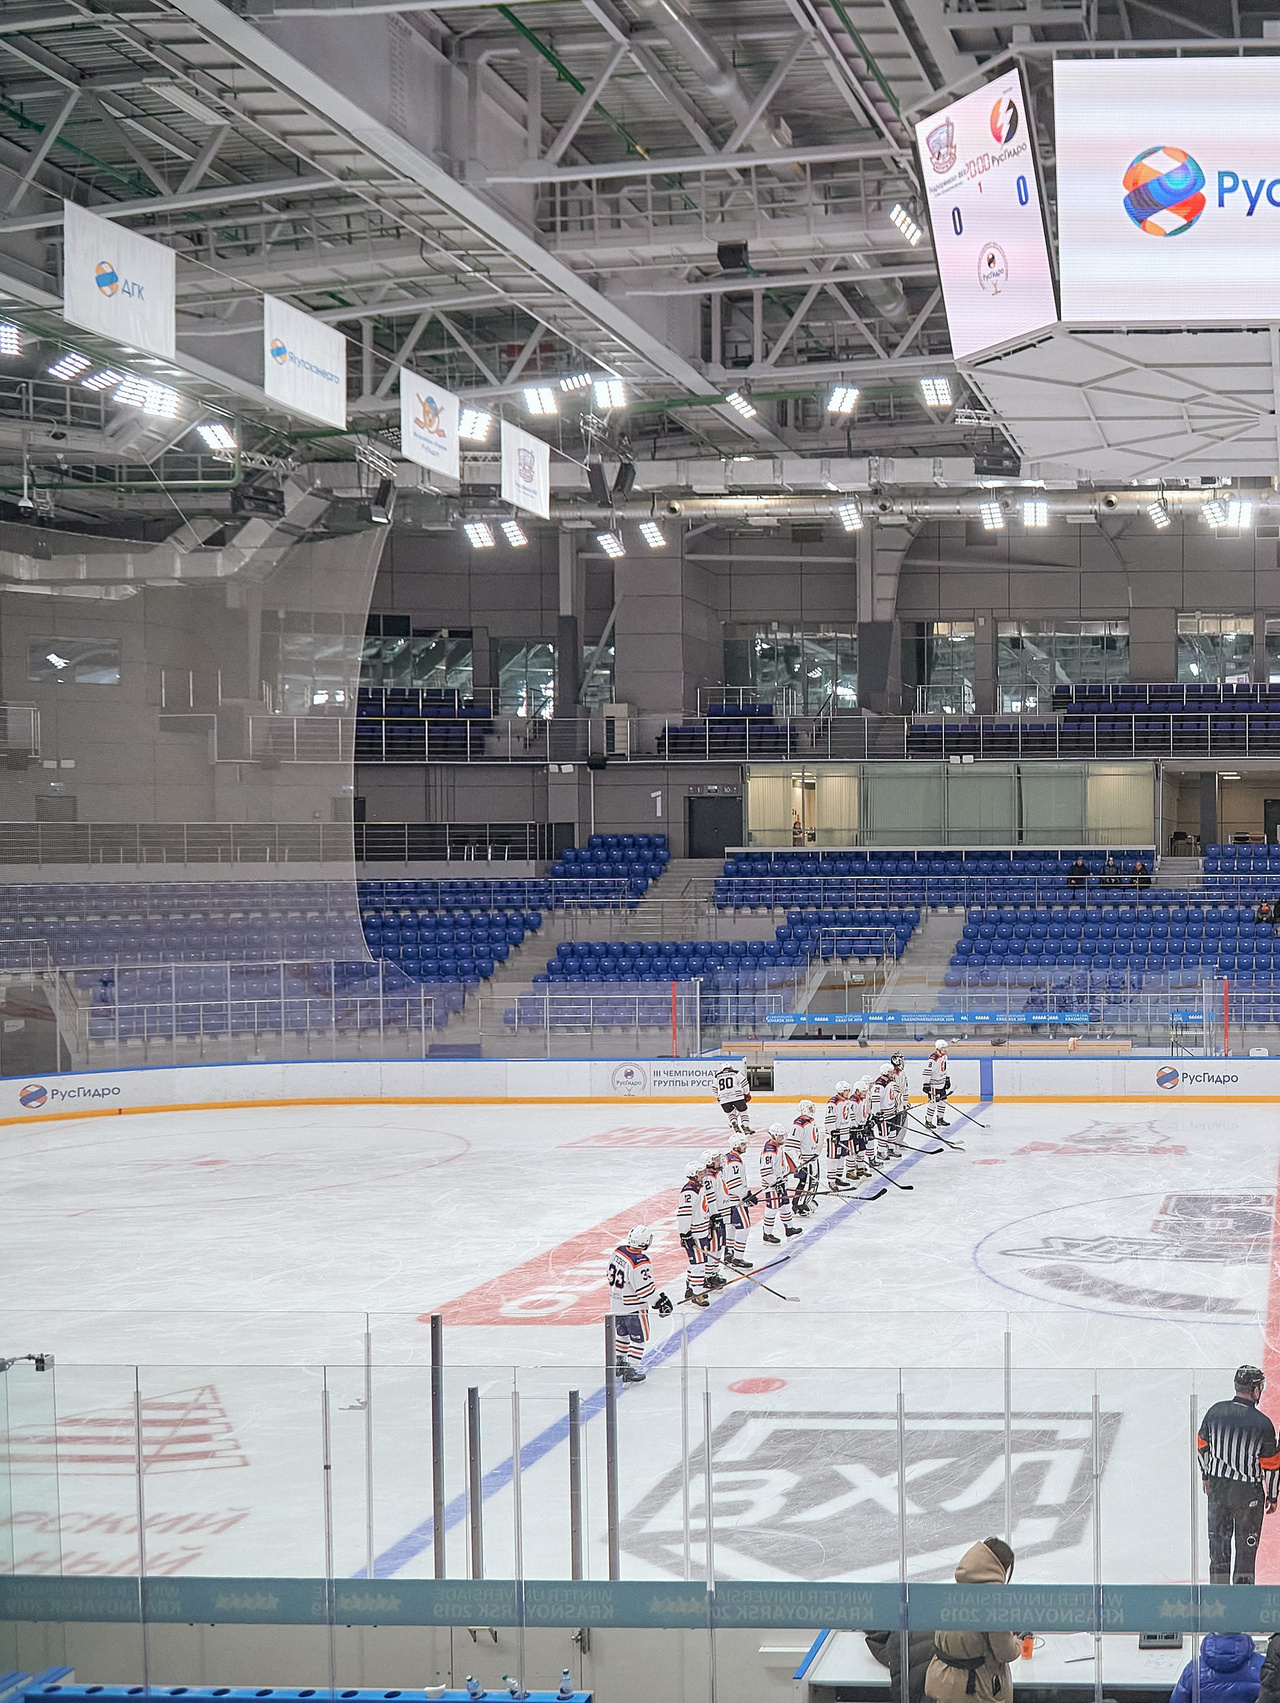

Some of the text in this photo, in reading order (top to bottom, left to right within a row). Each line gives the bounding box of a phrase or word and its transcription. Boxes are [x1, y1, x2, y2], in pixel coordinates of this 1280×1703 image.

[991, 143, 1028, 168] РусГидро
[1016, 175, 1029, 206] 0
[951, 206, 963, 236] 0
[121, 278, 145, 301] ДГК
[650, 790, 662, 817] 1
[718, 1077, 733, 1091] 80
[1181, 1072, 1239, 1085] РусГидро
[51, 1087, 121, 1101] РусГидро
